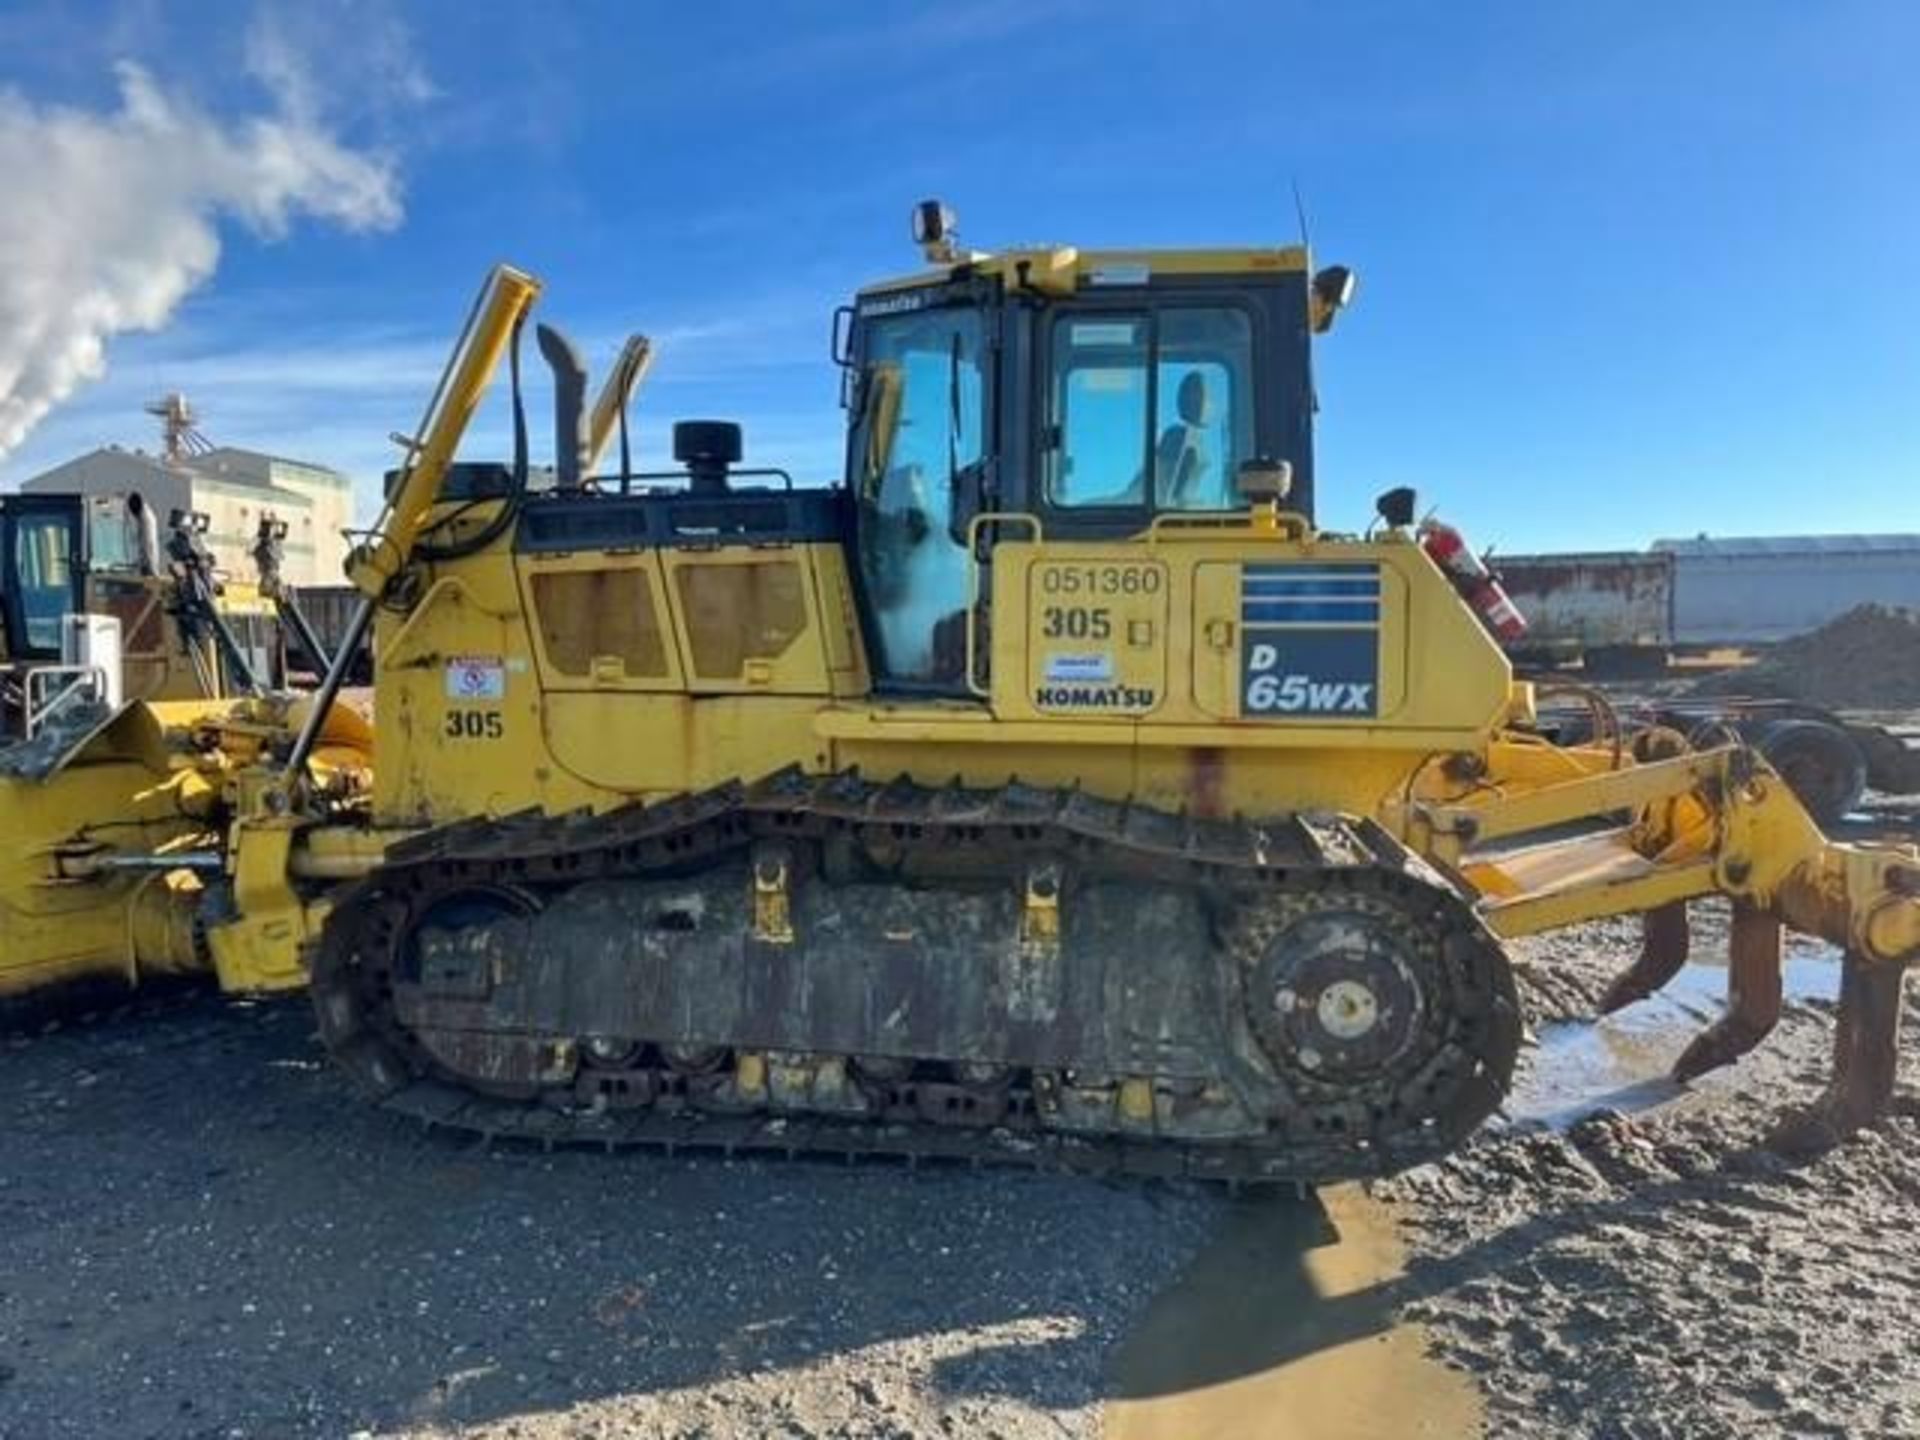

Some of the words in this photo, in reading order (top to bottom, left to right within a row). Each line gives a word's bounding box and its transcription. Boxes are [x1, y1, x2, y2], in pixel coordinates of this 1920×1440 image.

[1044, 567, 1159, 594] 051360
[1043, 607, 1111, 639] 305
[1250, 643, 1277, 671] D
[1036, 684, 1154, 706] KOMATSU
[446, 710, 503, 738] 305
